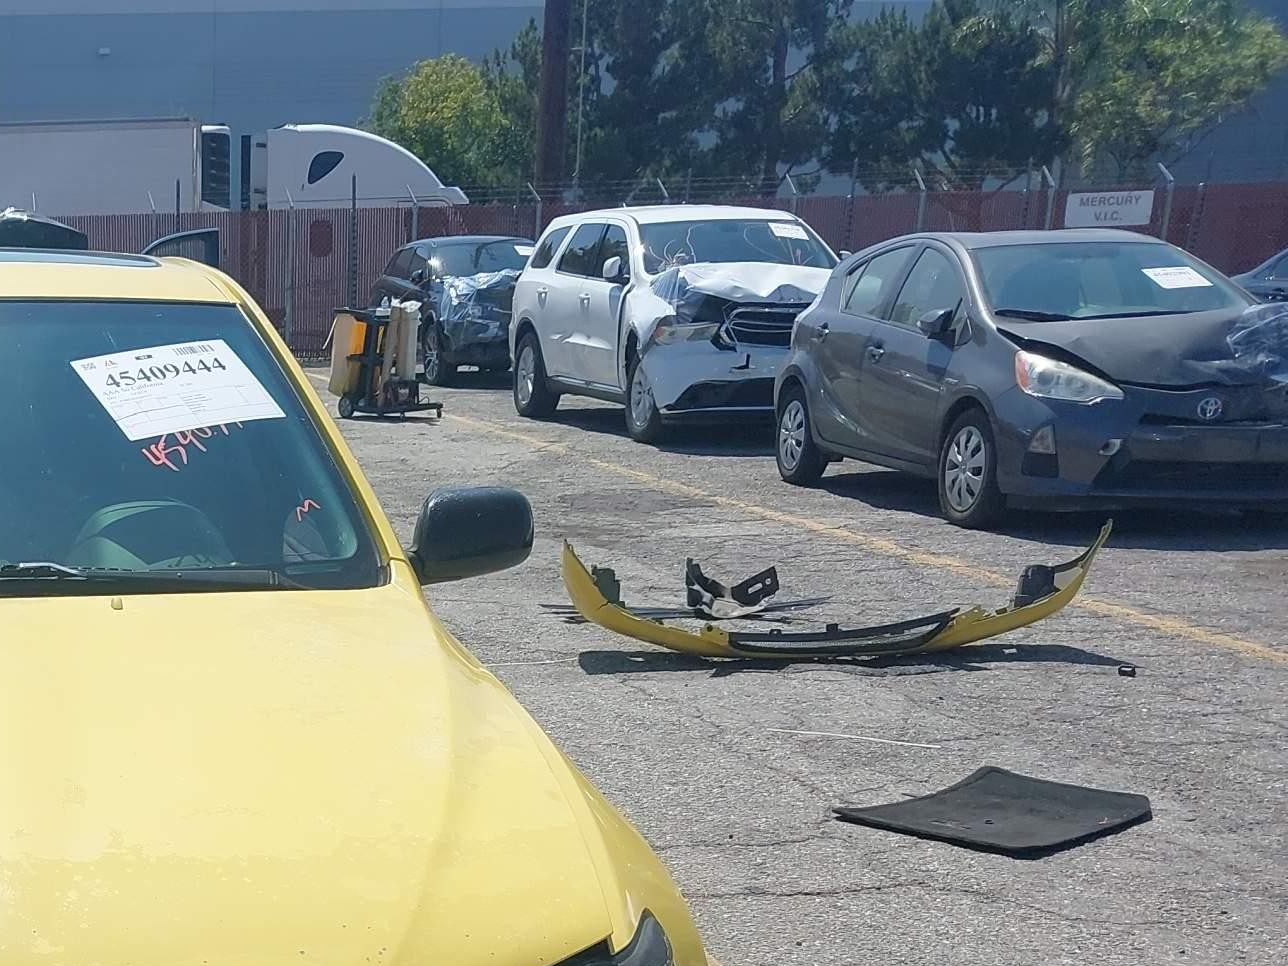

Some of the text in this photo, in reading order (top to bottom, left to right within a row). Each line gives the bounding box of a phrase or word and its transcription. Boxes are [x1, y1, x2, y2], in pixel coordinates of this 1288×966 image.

[1079, 194, 1142, 207] MERCURY
[1094, 211, 1123, 222] V.I.C.
[106, 357, 226, 388] 45409444
